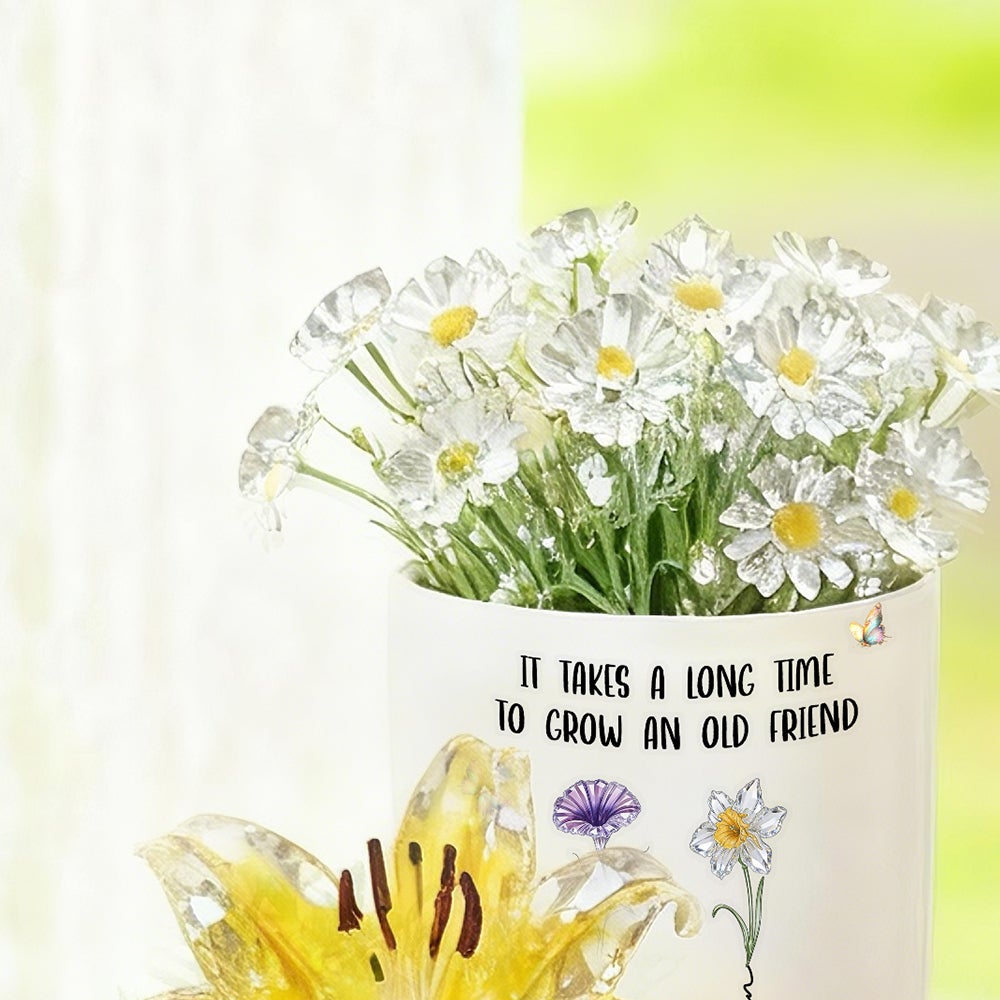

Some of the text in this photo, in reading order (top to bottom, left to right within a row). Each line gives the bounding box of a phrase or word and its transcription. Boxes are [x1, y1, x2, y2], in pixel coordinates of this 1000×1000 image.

[520, 653, 835, 700] IT TAKES A LONG TIME
[495, 697, 859, 751] TO GROW AN OLD FRIEND
